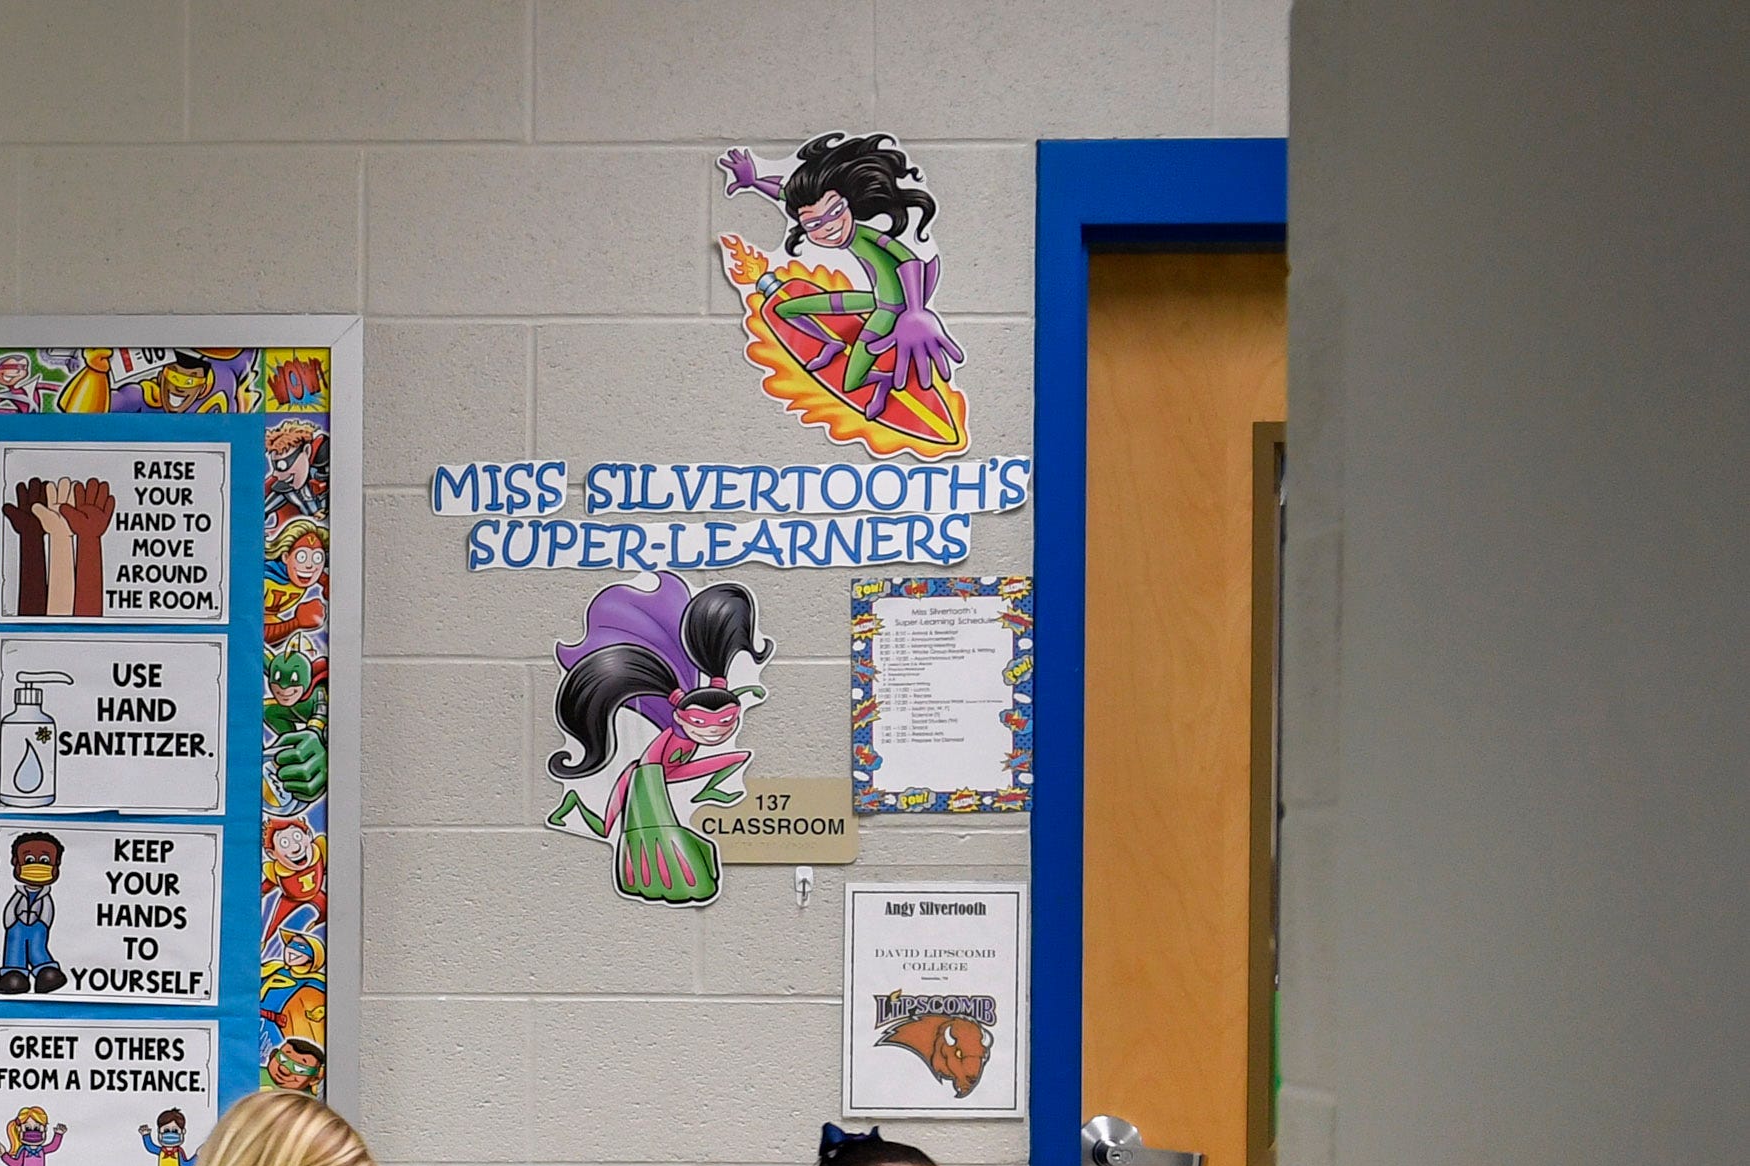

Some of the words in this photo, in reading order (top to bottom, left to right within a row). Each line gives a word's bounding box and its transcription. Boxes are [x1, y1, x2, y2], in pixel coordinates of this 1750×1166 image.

[268, 358, 328, 405] WOW!
[133, 460, 196, 481] RAISE
[134, 486, 194, 507] YOUR
[434, 462, 567, 514] MISS
[587, 459, 1031, 512] SILVERTOOTH'S
[115, 512, 176, 532] HAND
[182, 513, 212, 533] TO
[131, 538, 195, 558] MOVE
[470, 514, 970, 570] SUPER-LEARNERS
[115, 564, 208, 584] AROUND
[105, 589, 143, 609] THE
[148, 591, 220, 610] ROOM.
[958, 617, 995, 625] Schedul
[112, 662, 163, 689] USE
[97, 697, 177, 723] HAND
[58, 729, 214, 758] SANITIZER.
[756, 795, 791, 810] 137
[901, 792, 929, 807] POW!
[702, 818, 844, 834] CLASSROOM
[114, 838, 175, 864] KEEP
[105, 870, 180, 897] YOUR
[96, 903, 187, 930] HANDS
[885, 902, 915, 916] Angy
[920, 902, 986, 916] Silvertooth
[122, 936, 159, 961] TO
[875, 949, 919, 958] DAVID
[924, 949, 996, 958] LIPSCOMB
[903, 963, 968, 971] COLLEGE
[70, 967, 210, 995] YOURSELF.
[9, 1035, 79, 1060] GREET
[94, 1036, 185, 1062] OTHERS
[65, 1069, 81, 1091] A
[90, 1069, 206, 1093] DISTANCE.
